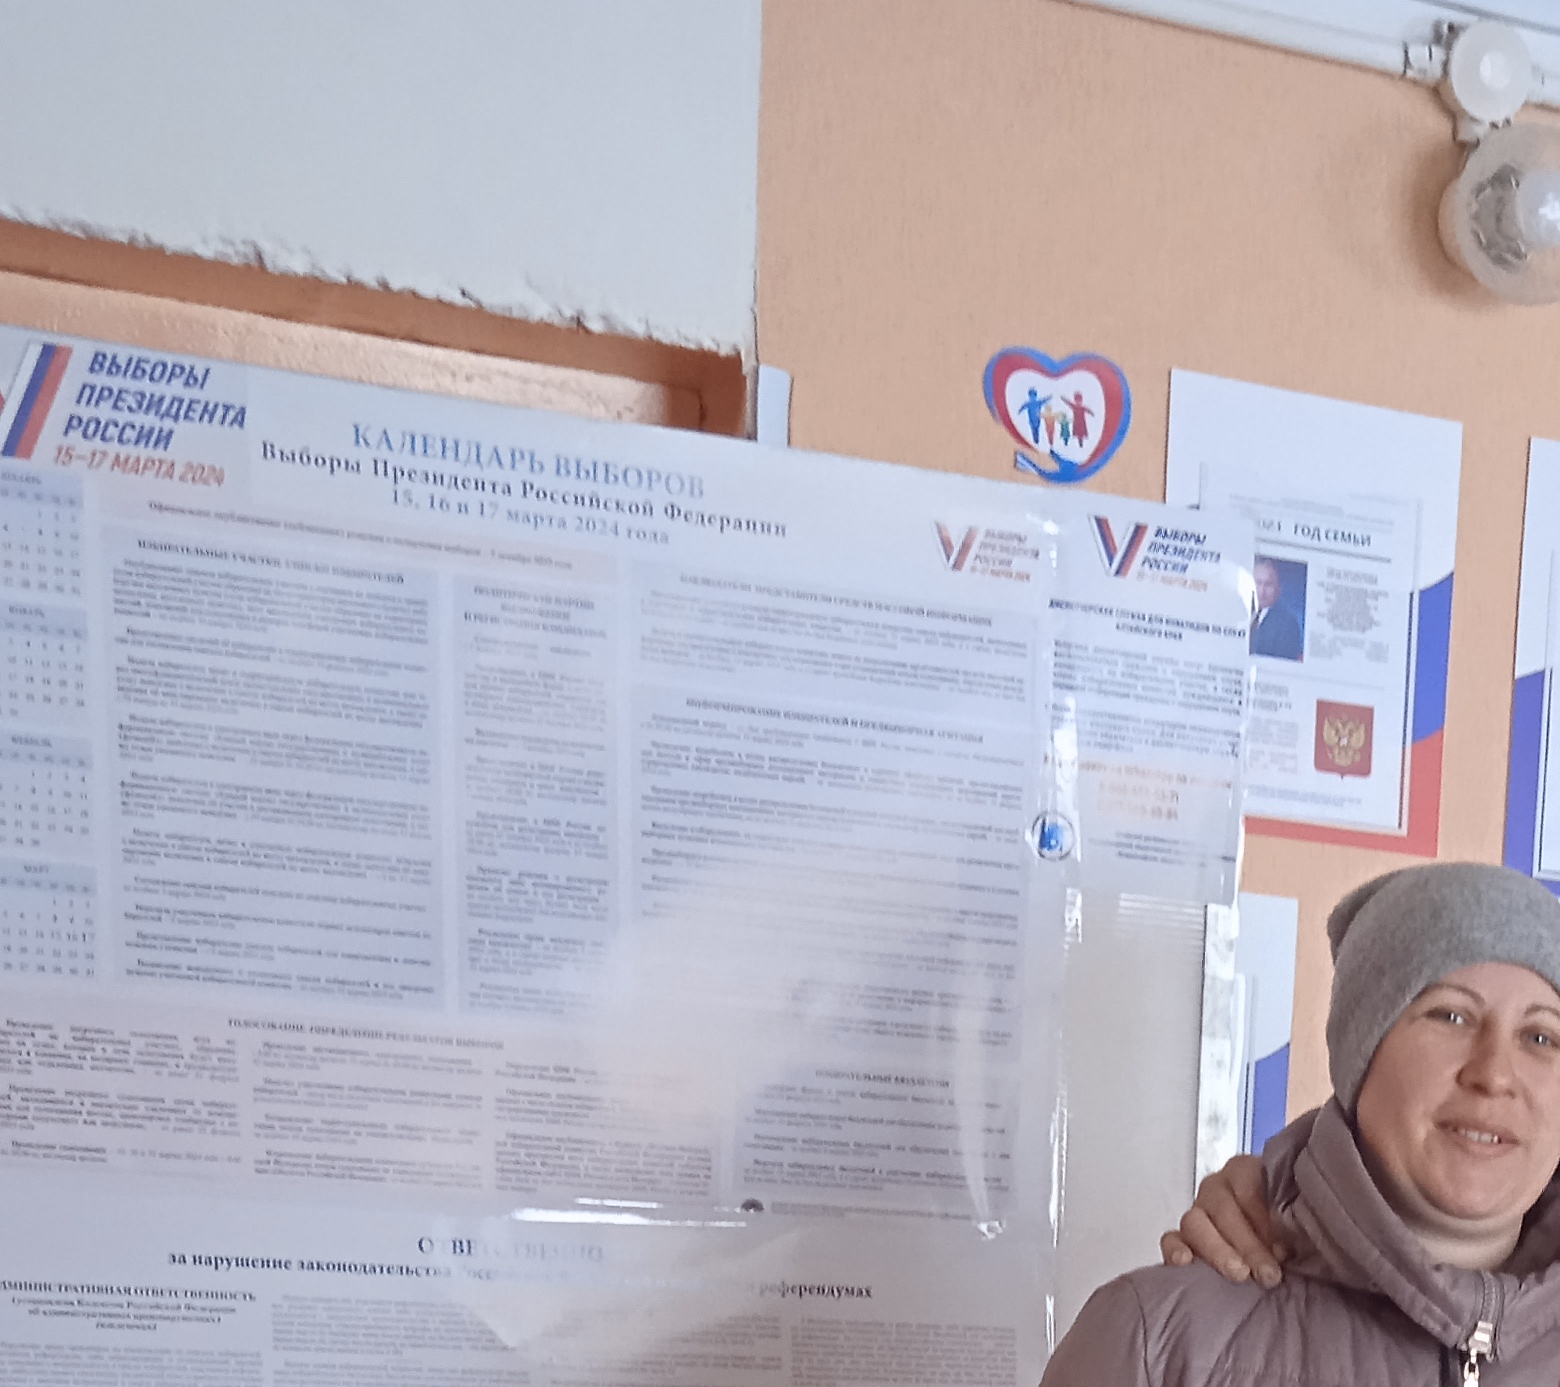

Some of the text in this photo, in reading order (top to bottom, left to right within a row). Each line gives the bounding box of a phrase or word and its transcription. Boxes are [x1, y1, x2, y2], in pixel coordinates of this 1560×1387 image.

[88, 350, 212, 391] ВЫБОРЫ
[75, 382, 247, 430] ПРЕЗИДЕНТА
[63, 413, 174, 451] РОССИИ
[110, 451, 175, 481] МАРТА
[178, 461, 225, 487] 2024
[352, 423, 705, 499] КАЛЕНДАРЬ ВЫБОРОВ
[261, 440, 788, 538] Выборы Президента Российской Федерации
[428, 494, 451, 514] 16
[456, 502, 470, 516] и
[477, 500, 498, 519] 17
[506, 509, 567, 533] марта
[574, 514, 620, 539] 2024
[625, 526, 670, 546] года
[1294, 523, 1320, 541] ГОД
[1325, 528, 1371, 547] СЕМЬИ
[1147, 541, 1221, 564] ПРЕЗИДЕНТА
[168, 1252, 187, 1266] за
[191, 1253, 292, 1275] нарушение
